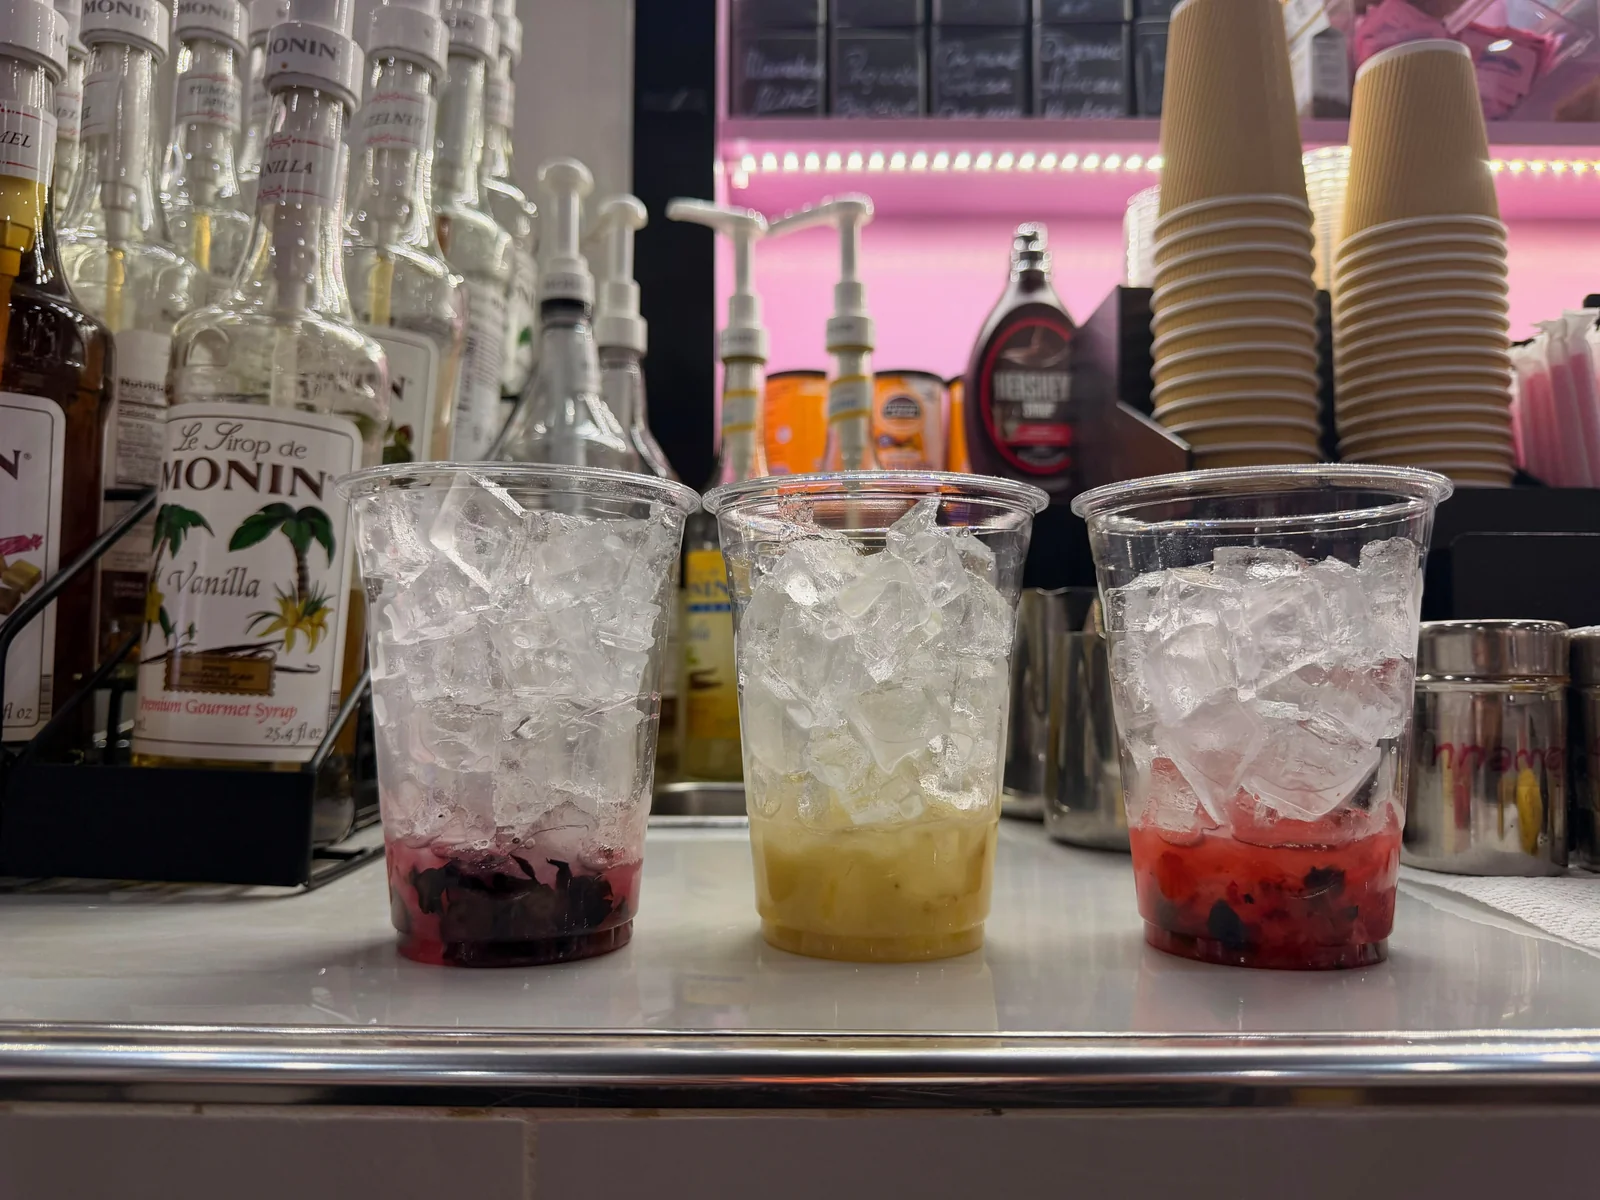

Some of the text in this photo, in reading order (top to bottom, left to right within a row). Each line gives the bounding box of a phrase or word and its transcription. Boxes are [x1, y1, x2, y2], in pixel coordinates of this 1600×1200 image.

[173, 422, 203, 452] Le
[204, 421, 271, 461] Sirop
[279, 440, 308, 460] de
[167, 560, 261, 598] Vanilla
[186, 698, 251, 718] Gourmet
[255, 702, 298, 726] Syrup
[265, 726, 293, 742] 25.4
